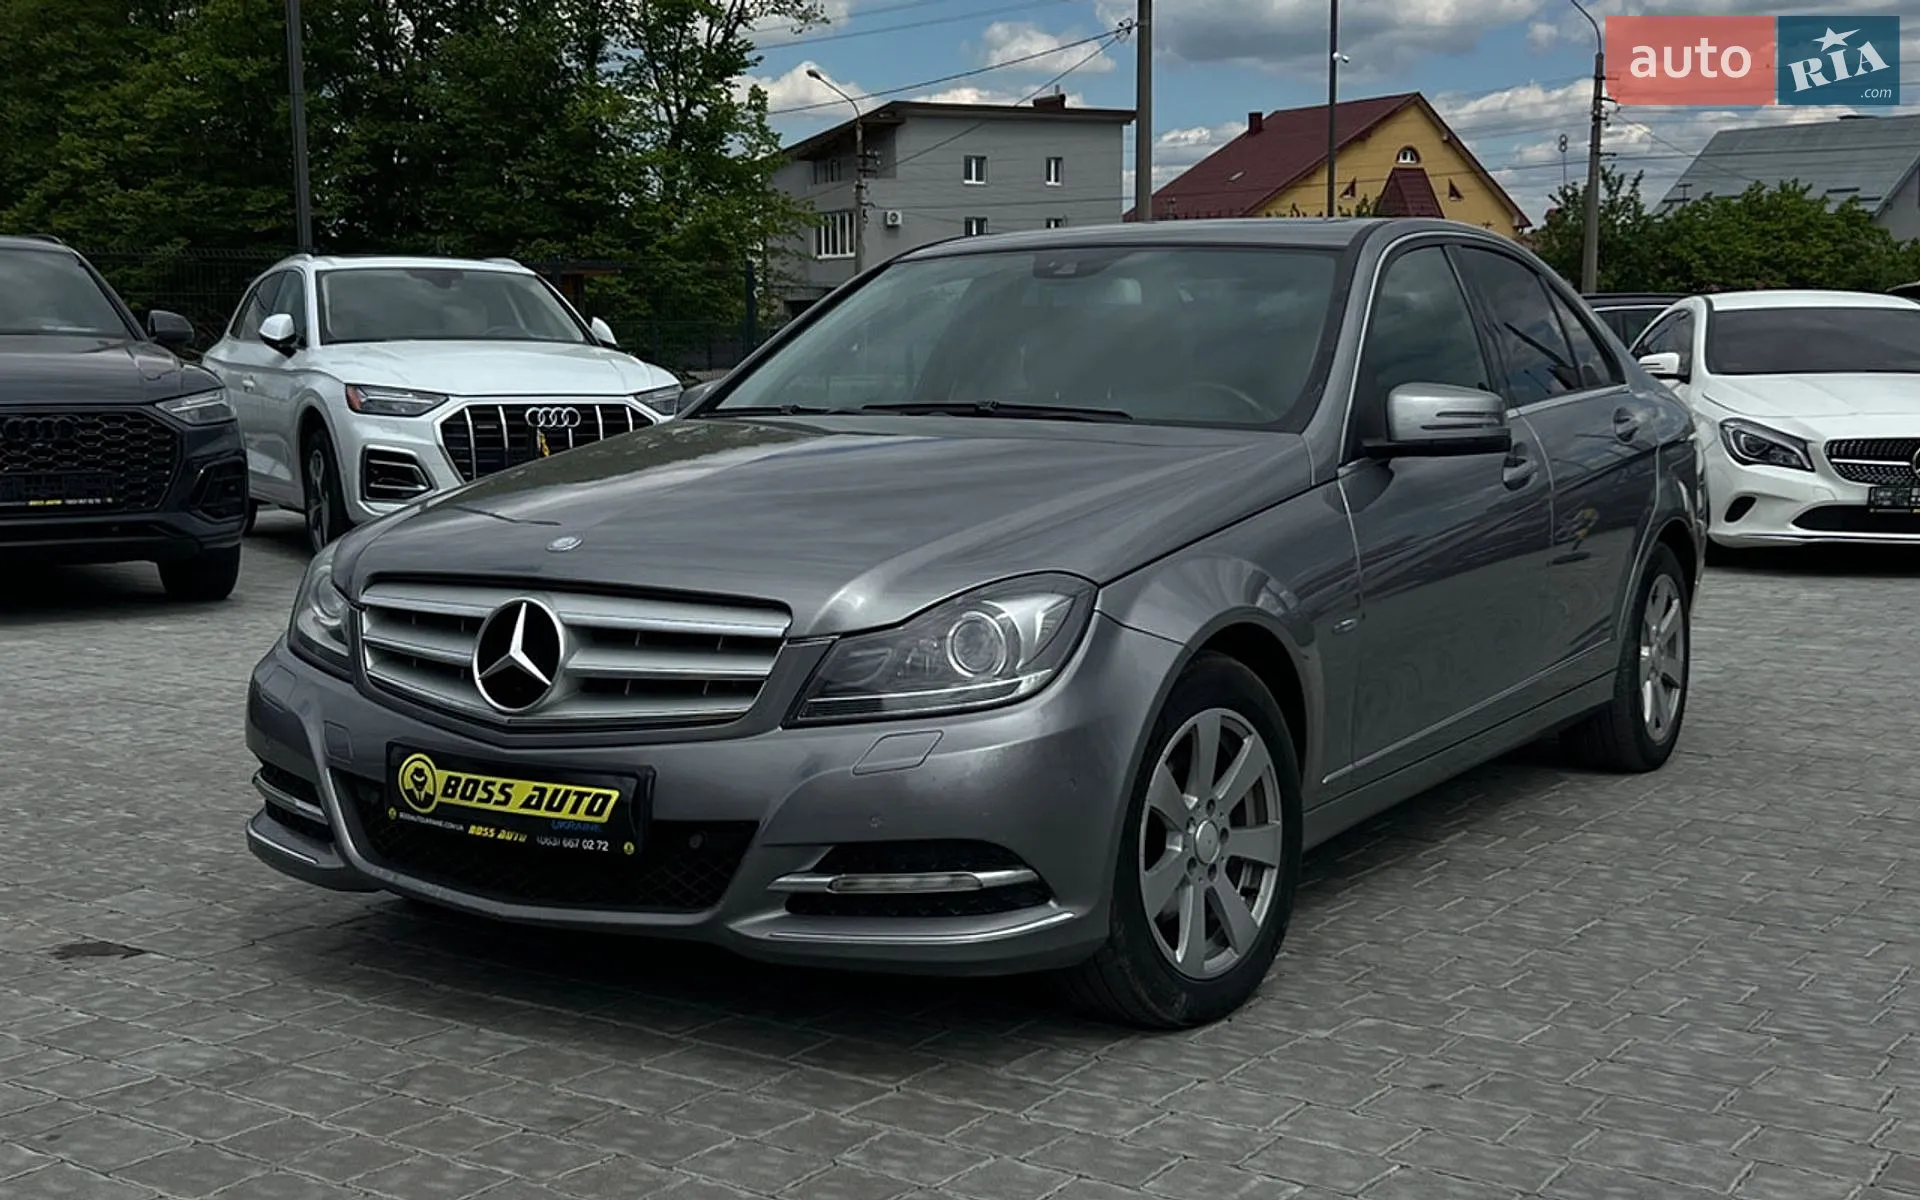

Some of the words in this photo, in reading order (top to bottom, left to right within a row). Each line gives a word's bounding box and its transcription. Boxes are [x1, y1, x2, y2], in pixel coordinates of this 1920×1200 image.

[440, 775, 515, 807] BOSS
[519, 786, 612, 817] AUTO
[468, 824, 496, 838] BOSS
[596, 840, 609, 852] 72
